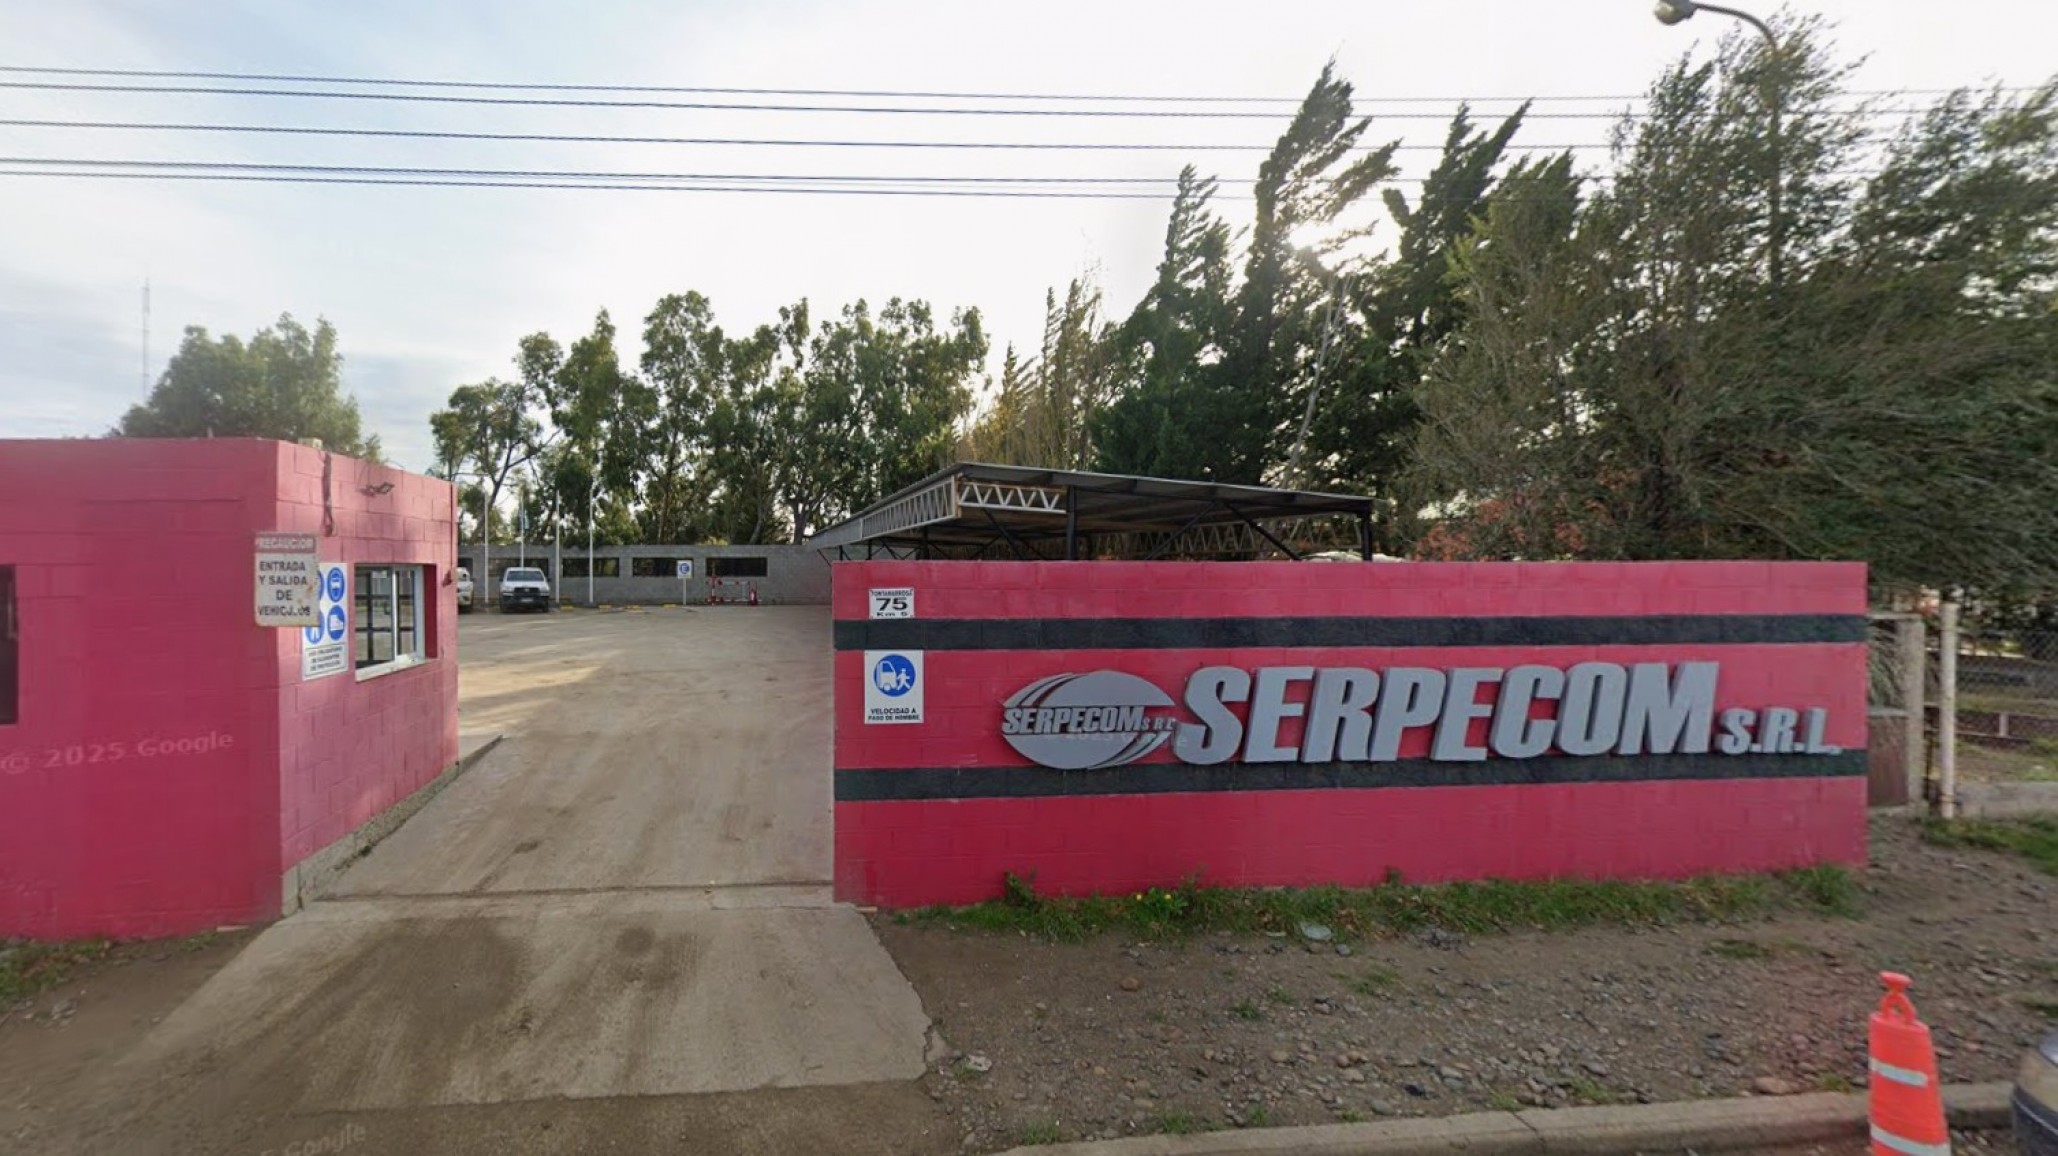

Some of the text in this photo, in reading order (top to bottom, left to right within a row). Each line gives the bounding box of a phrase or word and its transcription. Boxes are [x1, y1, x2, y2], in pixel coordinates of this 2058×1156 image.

[259, 561, 306, 571] ENTRADA
[258, 575, 307, 585] Y SALIDA
[276, 590, 293, 601] DE
[876, 597, 908, 612] 75
[1002, 705, 1145, 735] SERPECOM
[1173, 661, 1720, 766] SERPECOM
